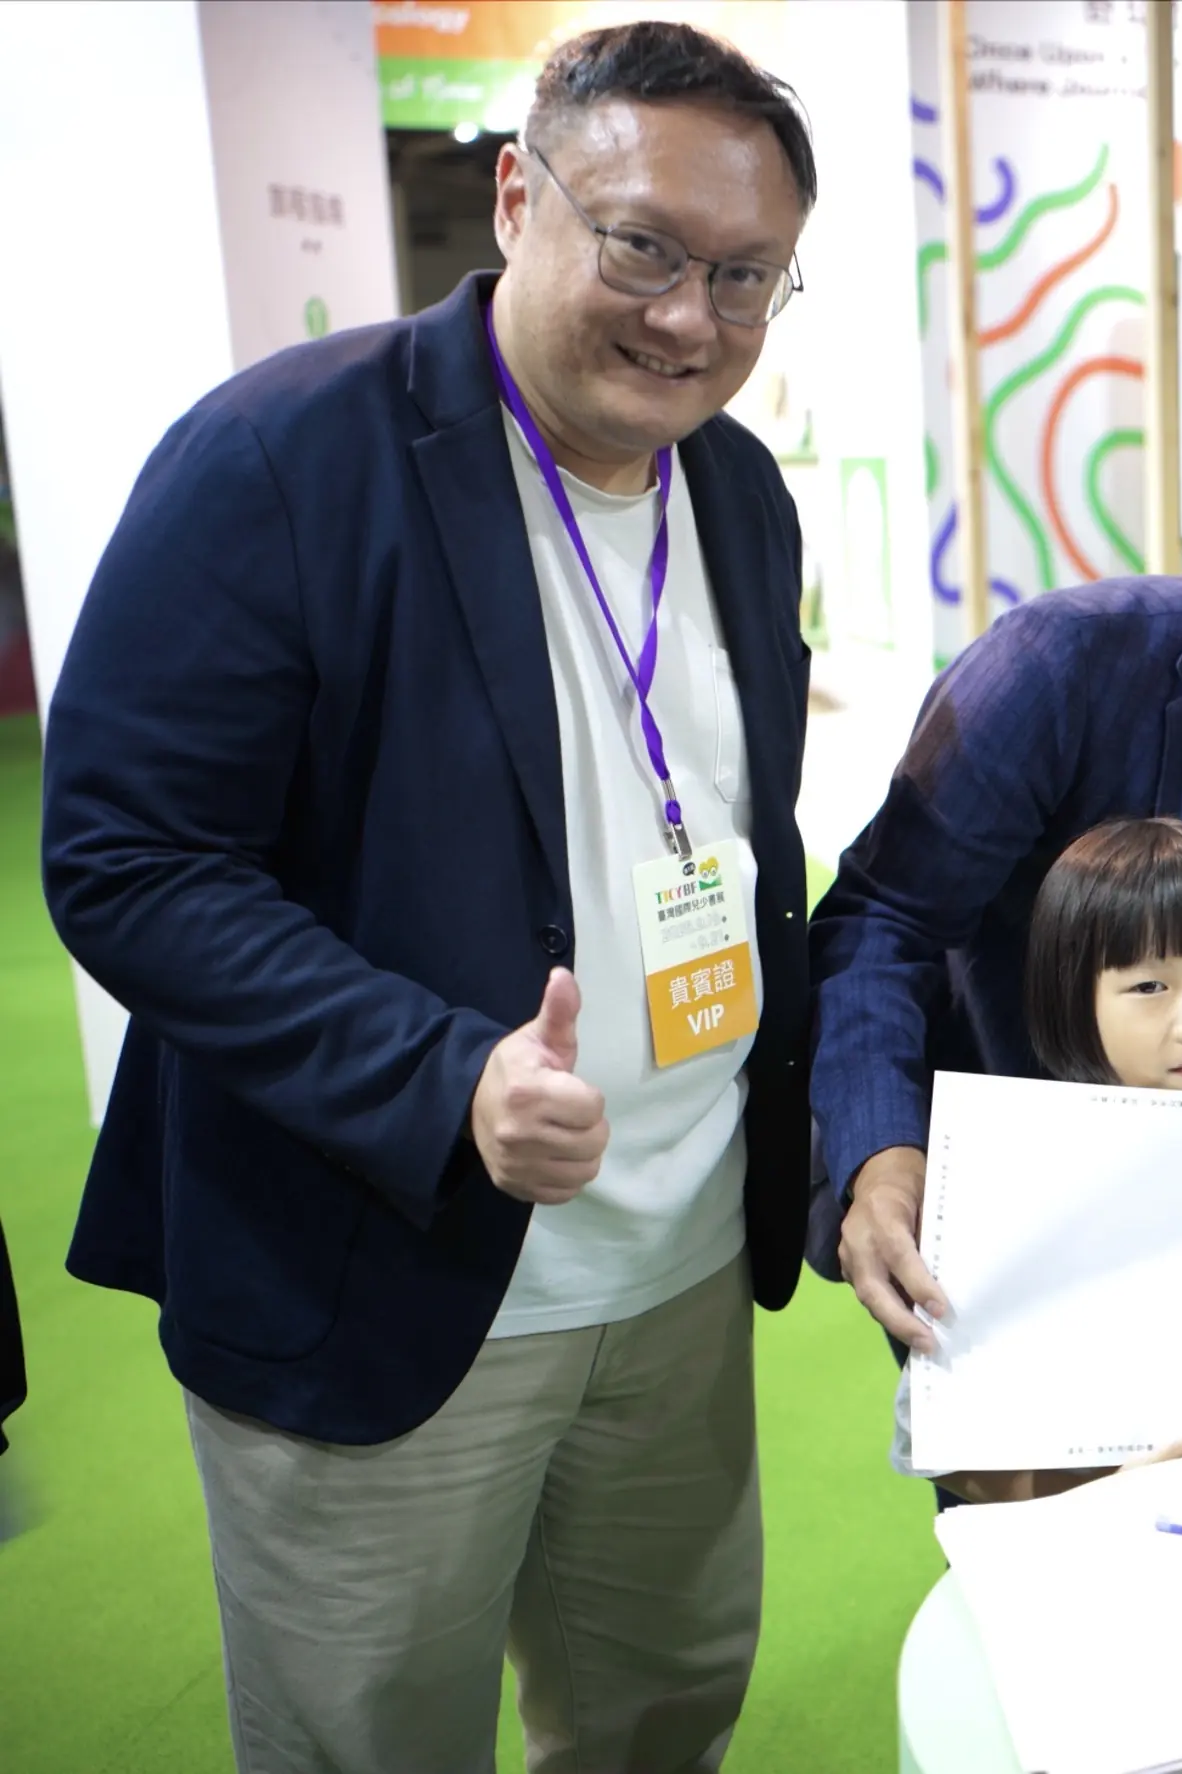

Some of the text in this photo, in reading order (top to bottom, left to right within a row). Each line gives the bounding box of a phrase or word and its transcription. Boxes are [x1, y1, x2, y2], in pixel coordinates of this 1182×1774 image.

[669, 959, 736, 1009] 貴賓證
[687, 1004, 725, 1035] VIP
